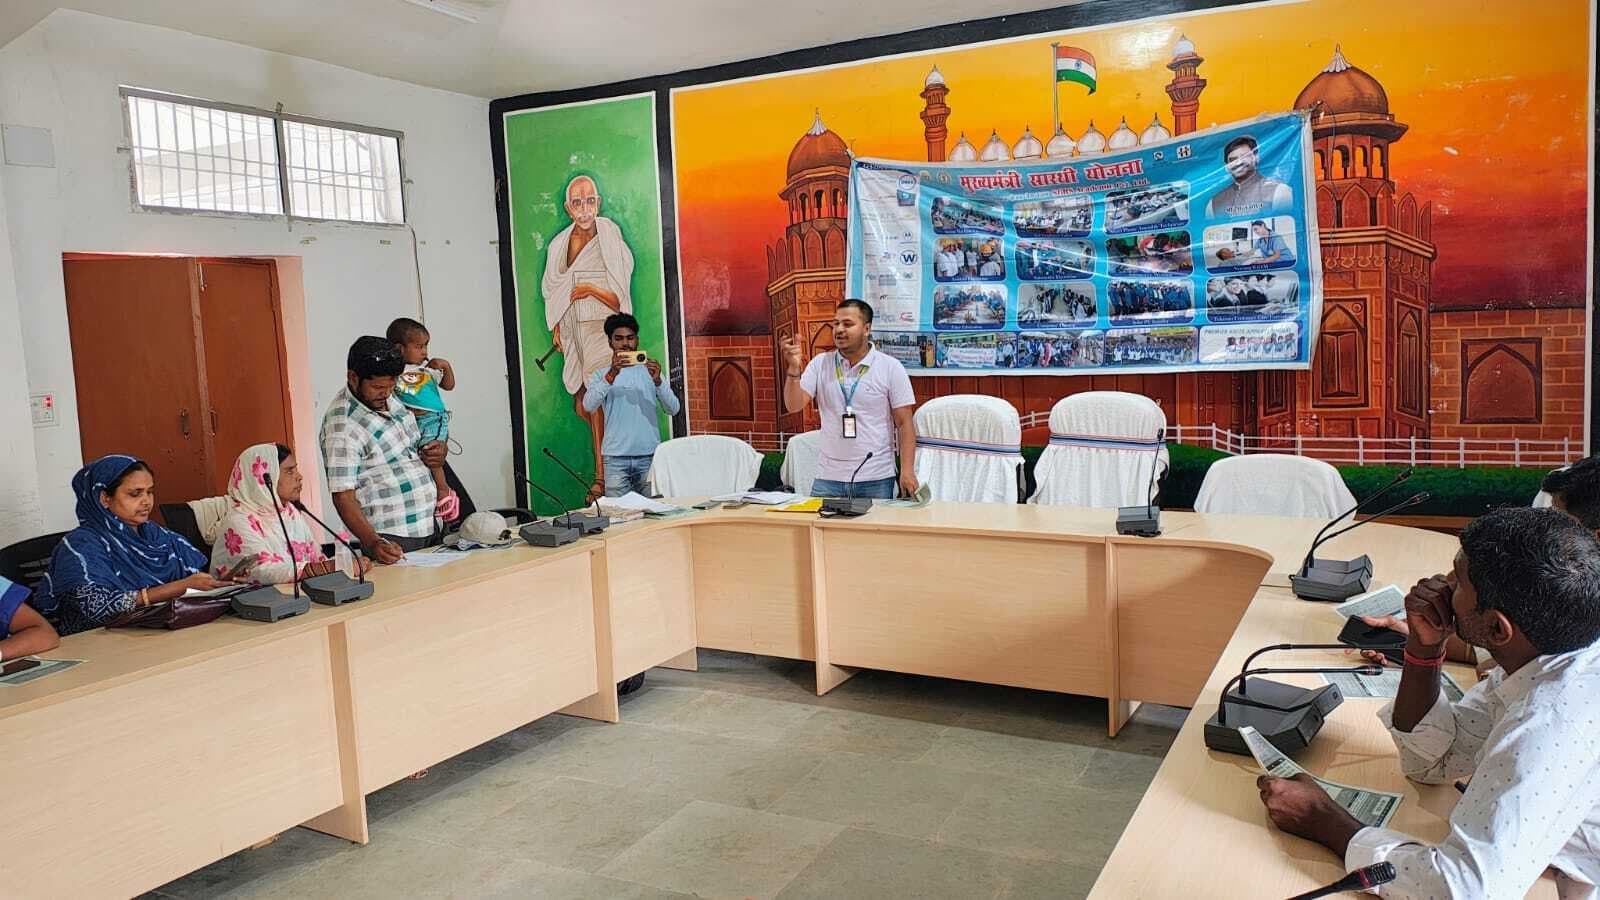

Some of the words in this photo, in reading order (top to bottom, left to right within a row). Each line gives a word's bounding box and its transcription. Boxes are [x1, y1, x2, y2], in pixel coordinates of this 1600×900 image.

[960, 171, 1022, 192] मुख्यमंत्री
[1029, 168, 1077, 187] सारथी
[1086, 160, 1142, 180] योजना
[902, 254, 916, 263] W
